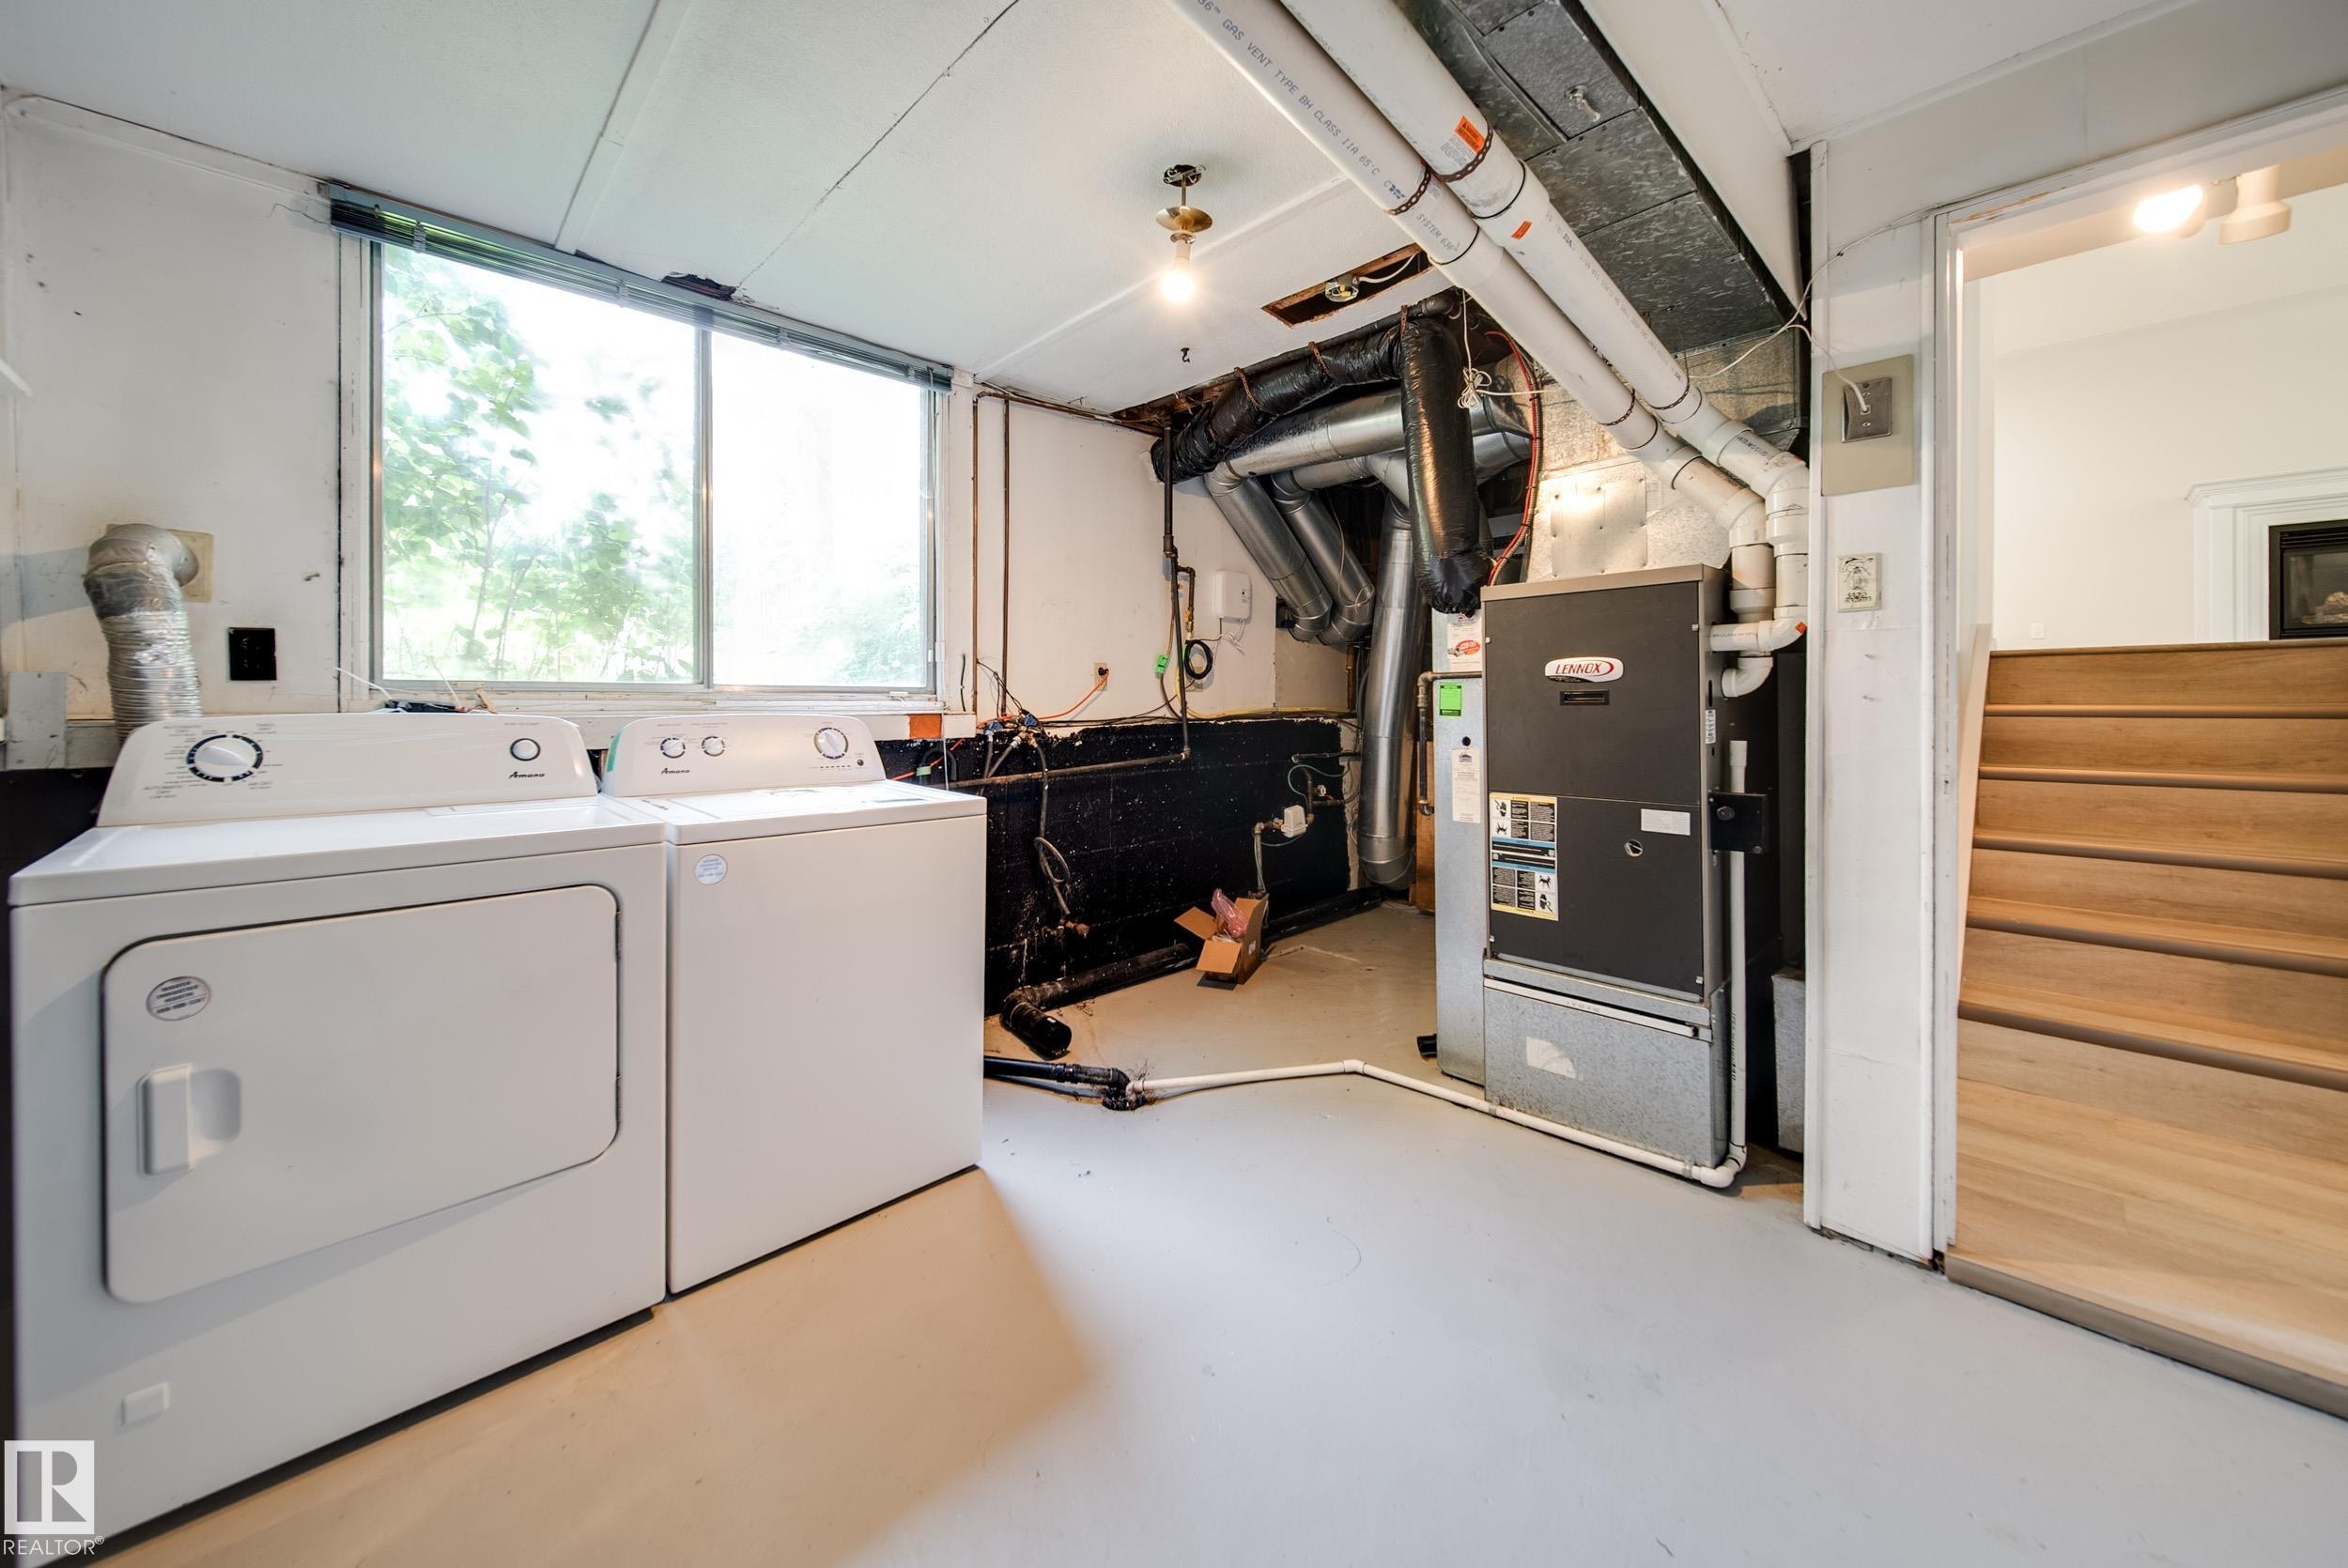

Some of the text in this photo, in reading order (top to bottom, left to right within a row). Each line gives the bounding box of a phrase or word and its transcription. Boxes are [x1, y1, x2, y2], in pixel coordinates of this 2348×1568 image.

[1222, 19, 1245, 41] GAS
[1246, 41, 1274, 68] VENT
[1274, 69, 1300, 95] TYPE
[1298, 95, 1314, 110] BH
[1313, 110, 1342, 137] CLASS
[1416, 213, 1442, 238] SYSTEM
[1555, 662, 1603, 675] LENNOX
[508, 771, 546, 779] Amana
